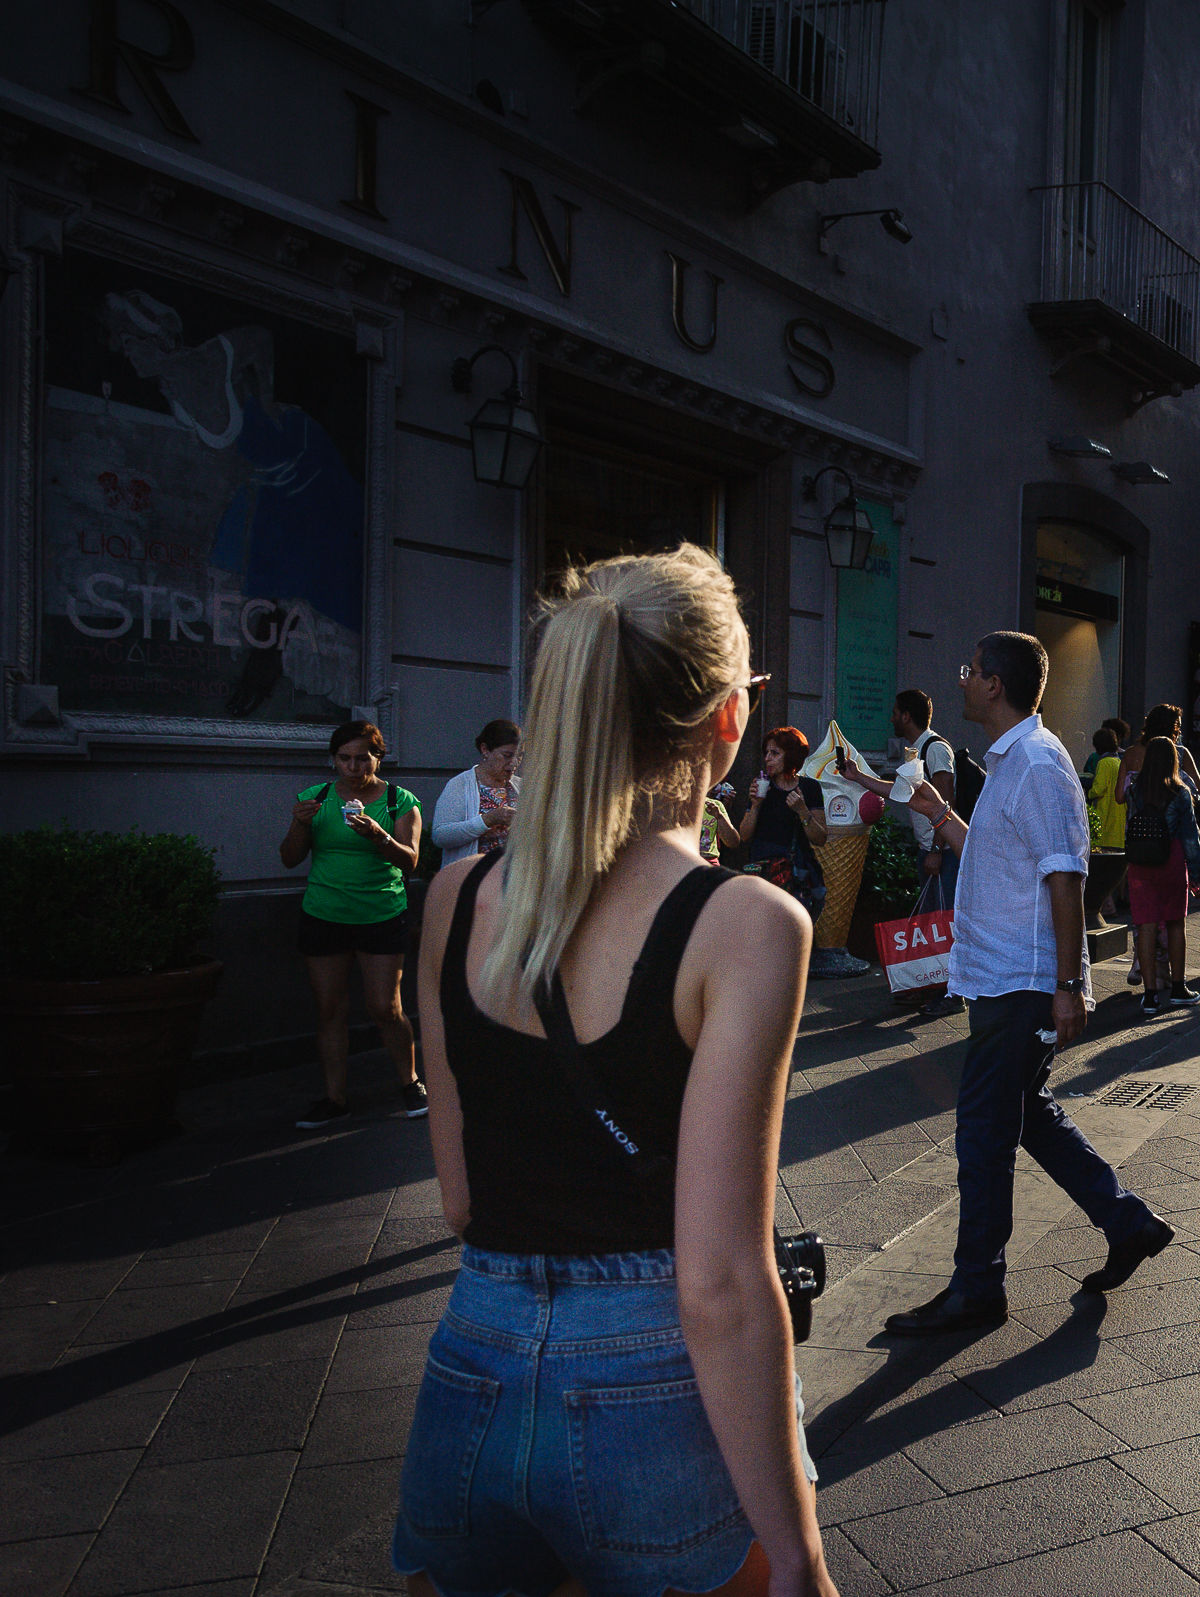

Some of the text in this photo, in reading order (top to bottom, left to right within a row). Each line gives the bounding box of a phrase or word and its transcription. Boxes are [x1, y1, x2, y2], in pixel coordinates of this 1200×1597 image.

[69, 0, 836, 398] RINUS
[66, 572, 319, 654] STREGA
[594, 1108, 639, 1155] SONY
